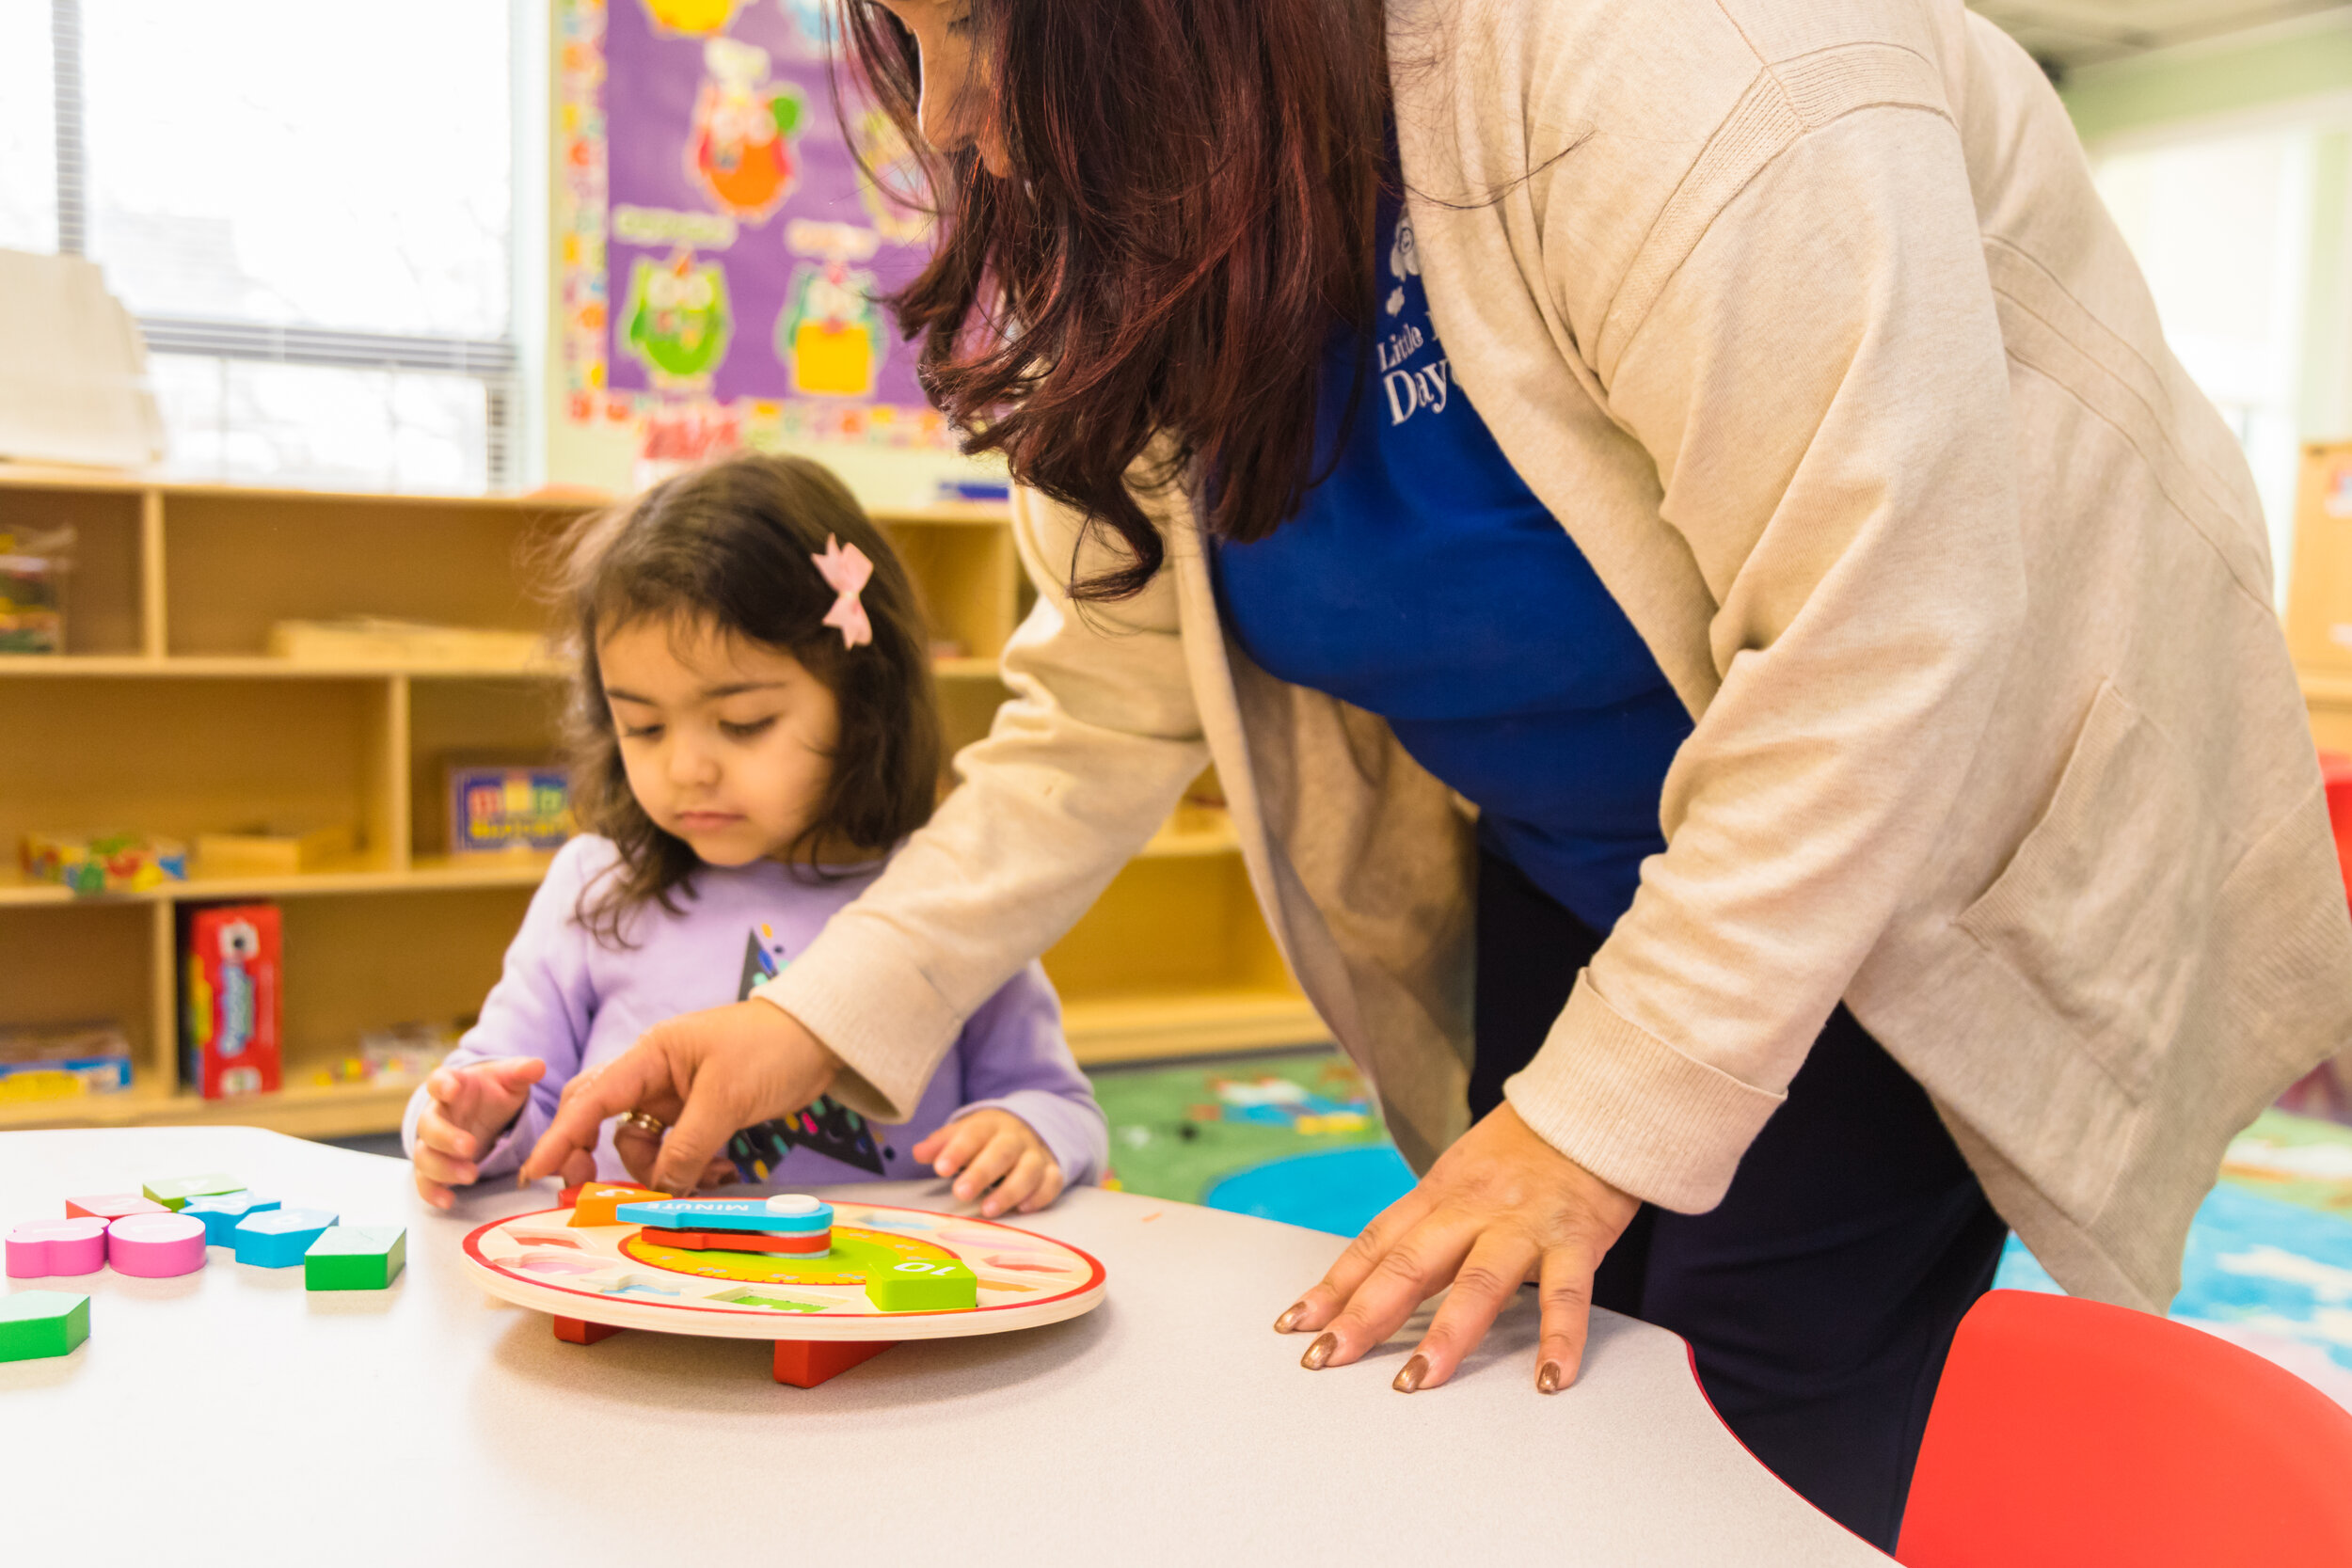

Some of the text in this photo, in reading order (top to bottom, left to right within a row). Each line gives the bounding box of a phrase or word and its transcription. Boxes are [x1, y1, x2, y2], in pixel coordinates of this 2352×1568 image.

[1377, 323, 1423, 372] Little
[646, 1202, 749, 1212] MINUTE
[893, 1262, 957, 1276] 10
